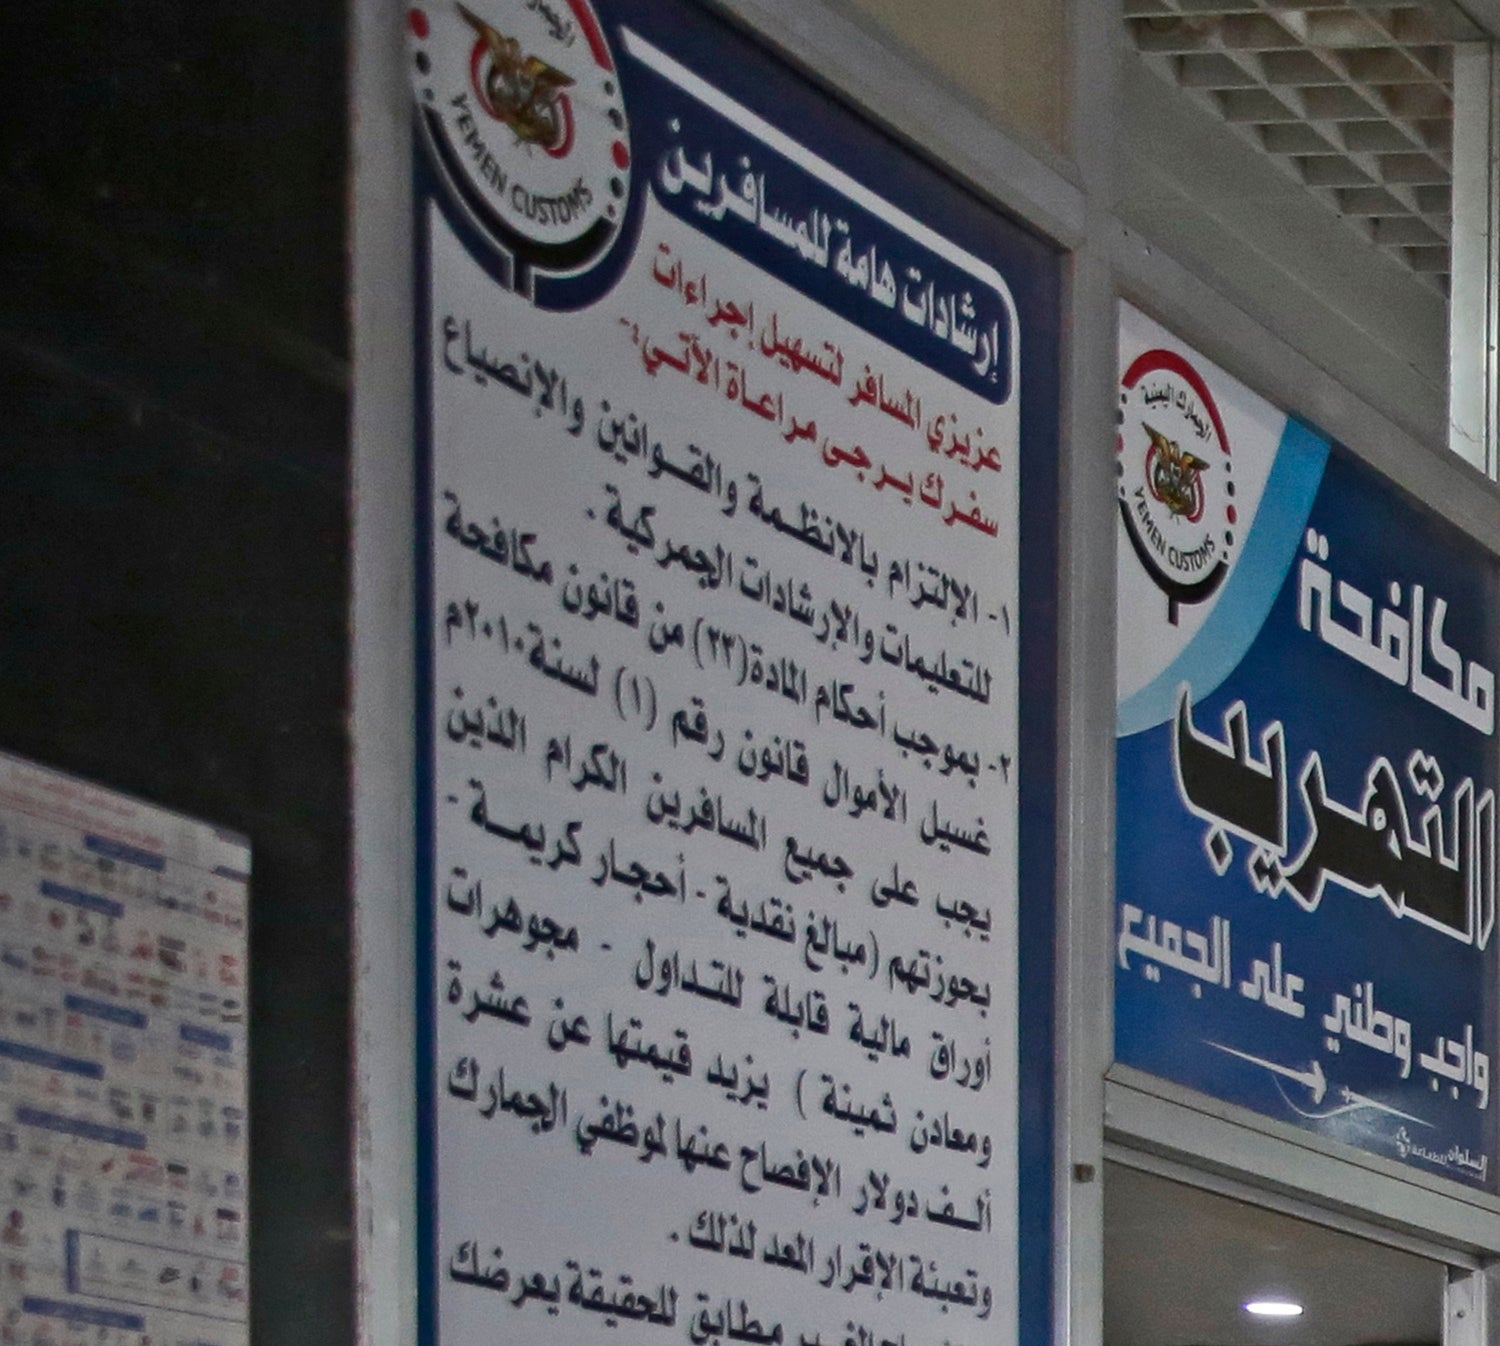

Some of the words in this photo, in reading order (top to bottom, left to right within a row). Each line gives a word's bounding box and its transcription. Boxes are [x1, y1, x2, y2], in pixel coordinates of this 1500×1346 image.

[451, 92, 508, 196] YEMEN
[511, 176, 594, 226] CUSTOMS
[658, 117, 833, 269] للمسافرين
[652, 242, 754, 350] إجراءات
[834, 218, 901, 312] هامة
[759, 312, 844, 387] لتسهيل
[901, 266, 999, 384] إرشادات
[442, 315, 585, 437] والإنصياع
[726, 360, 817, 444] مراعاة
[848, 364, 921, 430] المسافر
[597, 399, 738, 518] والقوانين
[821, 438, 914, 506] يرجى
[926, 413, 1002, 473] عزيزي
[919, 472, 998, 538] سفرك
[1134, 486, 1167, 556] YEMEN
[1167, 533, 1216, 572] CUSTOMS
[739, 556, 875, 665] والإرشادات
[888, 559, 978, 628] الإلتزام
[1297, 526, 1496, 737] مكافحة
[879, 623, 993, 705] للتعليمات
[445, 685, 526, 753] الذين
[545, 735, 627, 794] الكرام
[645, 772, 767, 852] المسافرين
[1173, 680, 1496, 950] التهريب
[783, 836, 855, 894] جميع
[870, 862, 919, 909] على
[935, 894, 991, 943] يجب
[1116, 902, 1231, 999] الجميع
[1238, 941, 1306, 1019] على
[1321, 980, 1412, 1079] وطني
[1416, 1024, 1490, 1110] واجب
[762, 1231, 814, 1275] المعد
[820, 1242, 904, 1302] الإقرار
[908, 1254, 992, 1320] وتعبئة
